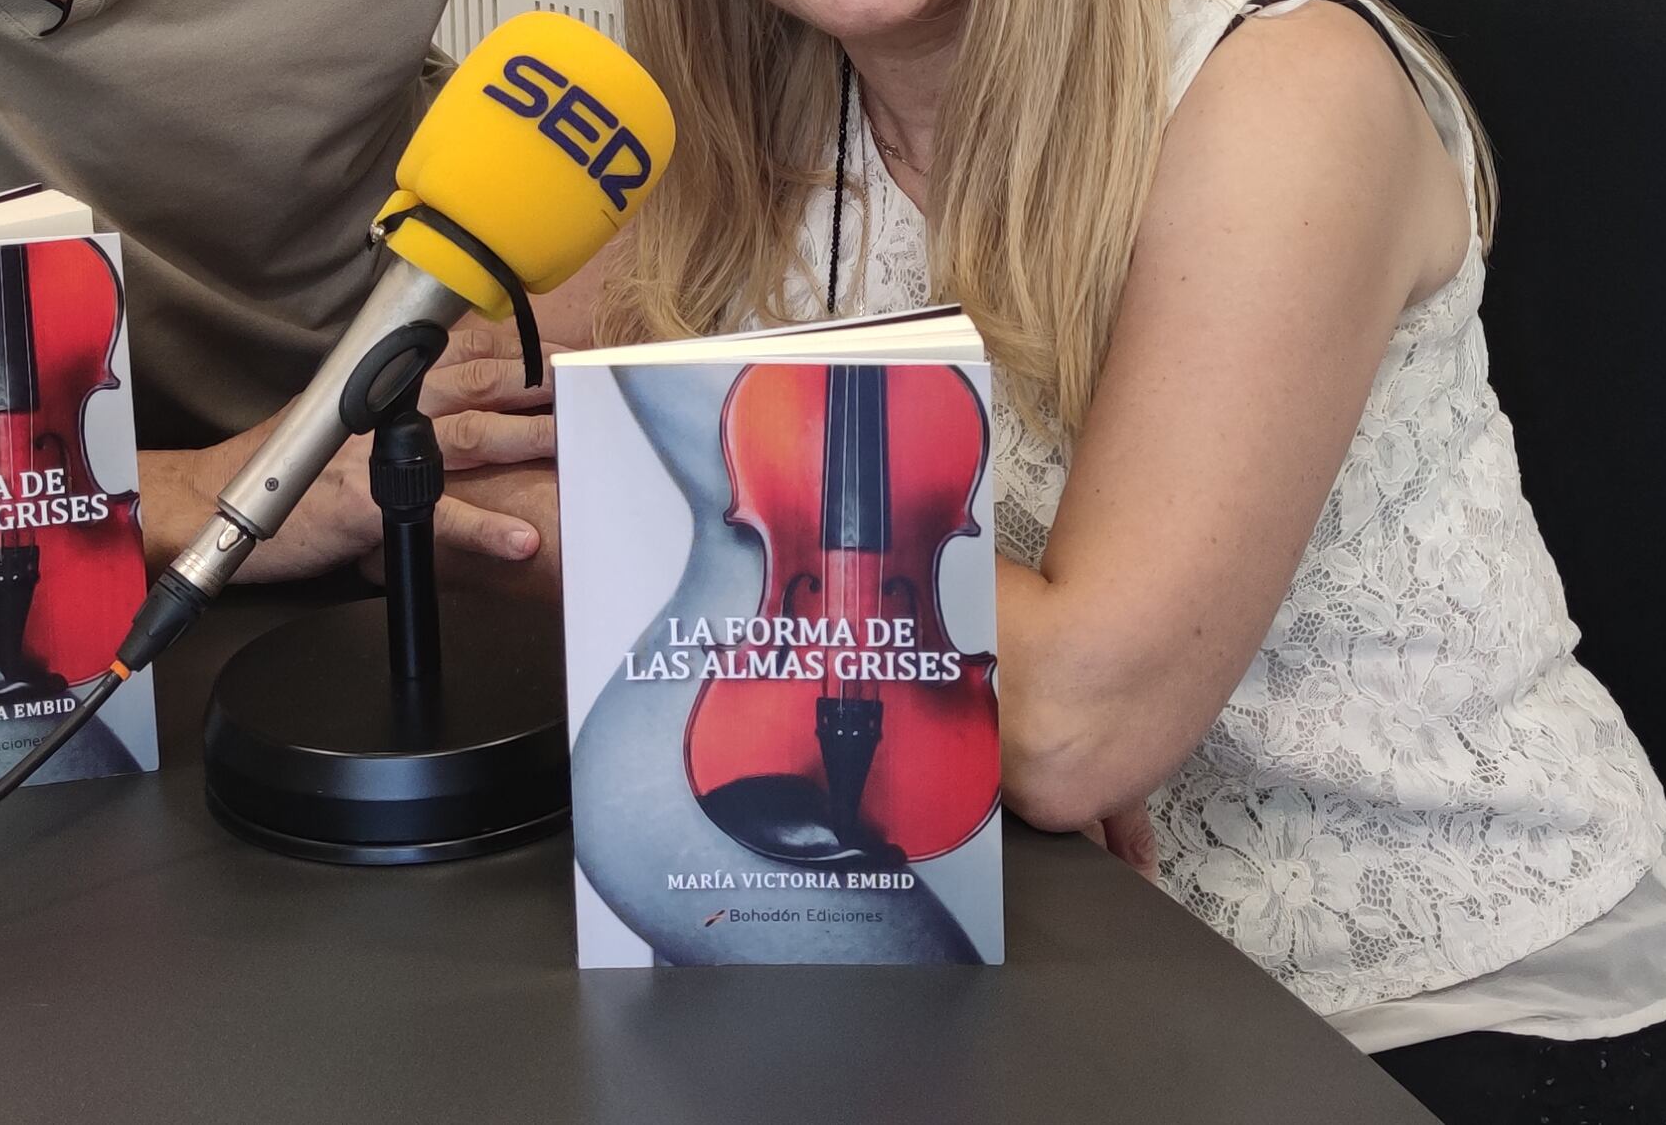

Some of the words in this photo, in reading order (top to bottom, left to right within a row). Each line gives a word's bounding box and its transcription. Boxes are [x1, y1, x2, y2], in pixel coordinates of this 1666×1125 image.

[482, 55, 652, 212] SER
[19, 468, 66, 498] DE
[667, 617, 719, 647] LA
[725, 617, 857, 647] FORMA
[865, 618, 915, 648] DE
[625, 650, 690, 681] LAS
[699, 650, 824, 680] ALMAS
[834, 651, 962, 681] GRISES
[14, 697, 77, 719] EMBID
[667, 869, 736, 890] MARÍA
[741, 872, 841, 890] VICTORIA
[846, 873, 915, 890] EMBID
[729, 908, 800, 923] Bohodón
[807, 908, 883, 923] Ediciones
